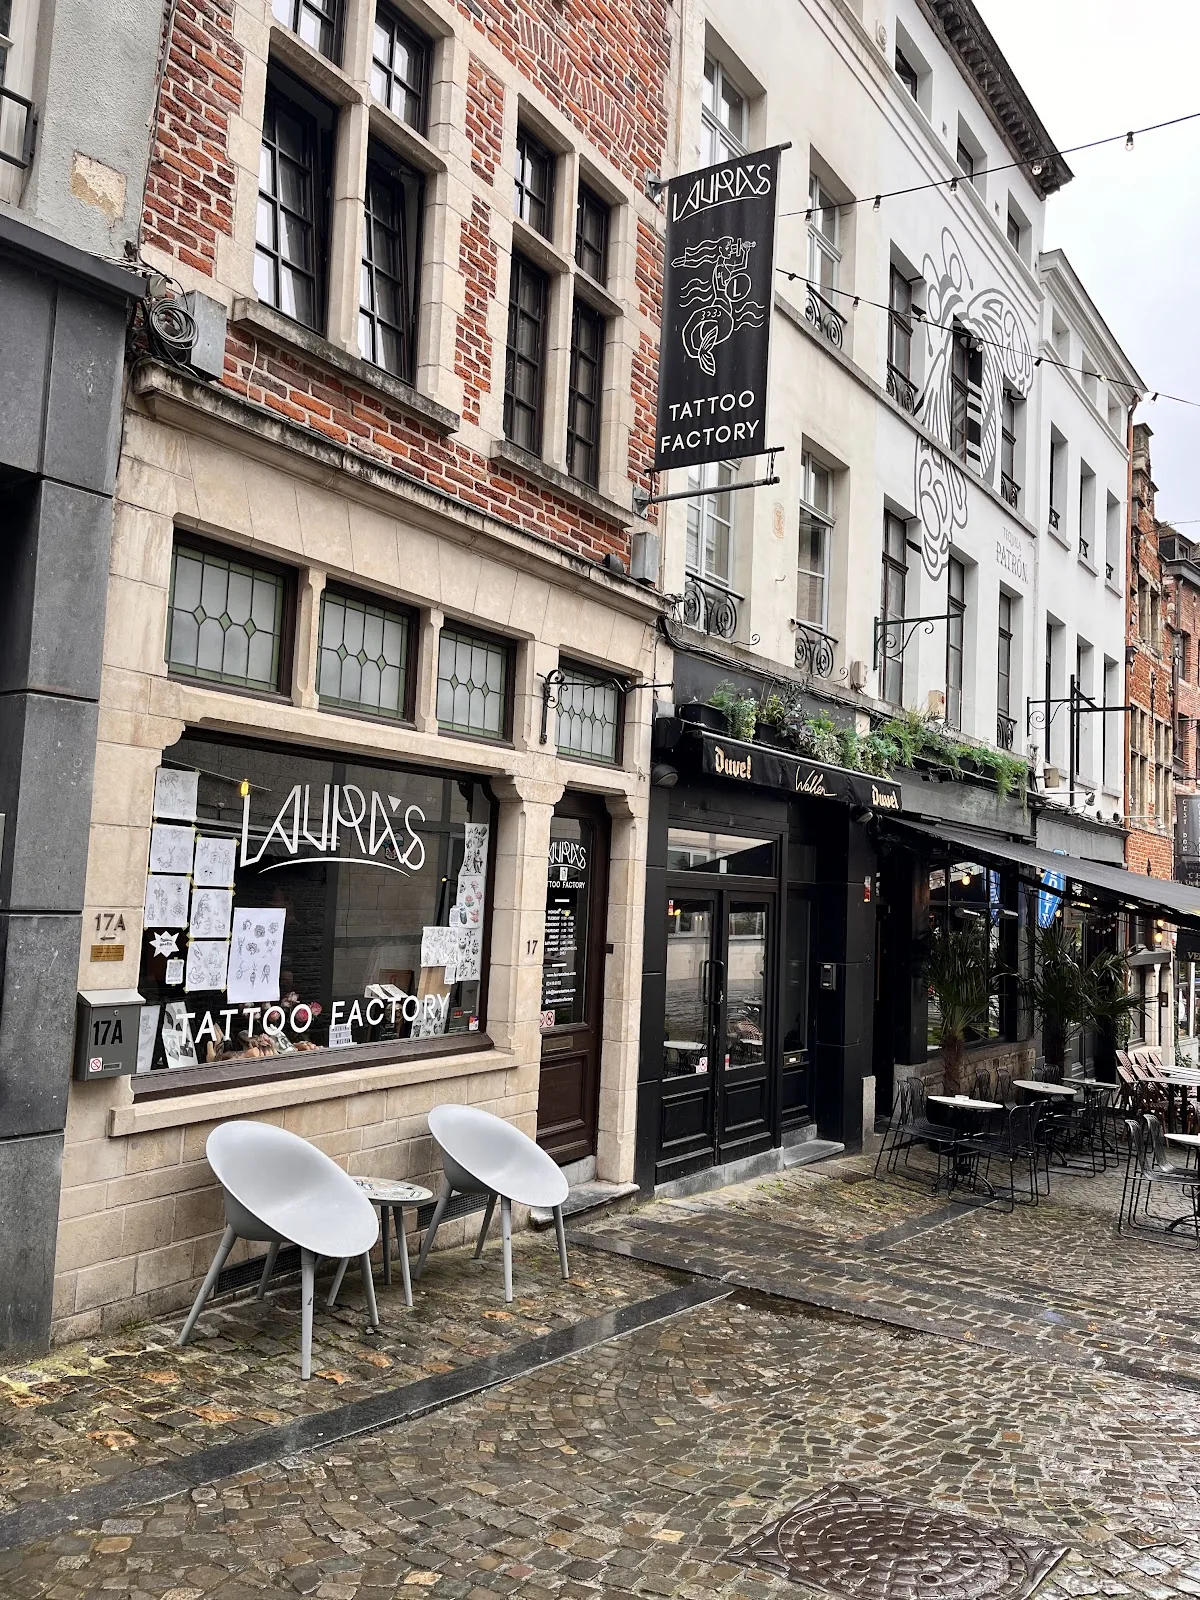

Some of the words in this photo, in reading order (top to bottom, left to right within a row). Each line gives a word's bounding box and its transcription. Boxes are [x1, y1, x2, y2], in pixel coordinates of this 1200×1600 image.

[672, 163, 771, 222] LAURA'S
[669, 391, 755, 421] TATTOO
[661, 420, 760, 453] FACTORY
[714, 746, 752, 780] Duvel
[871, 785, 900, 810] Duvel
[240, 784, 426, 871] LAURA'S
[549, 841, 587, 869] AURA'S
[562, 881, 586, 889] FACTORY
[95, 913, 126, 931] 17A
[527, 940, 538, 955] 17
[92, 1019, 123, 1046] 17A
[175, 1003, 312, 1044] TATTOO
[330, 993, 451, 1030] FACTORY
